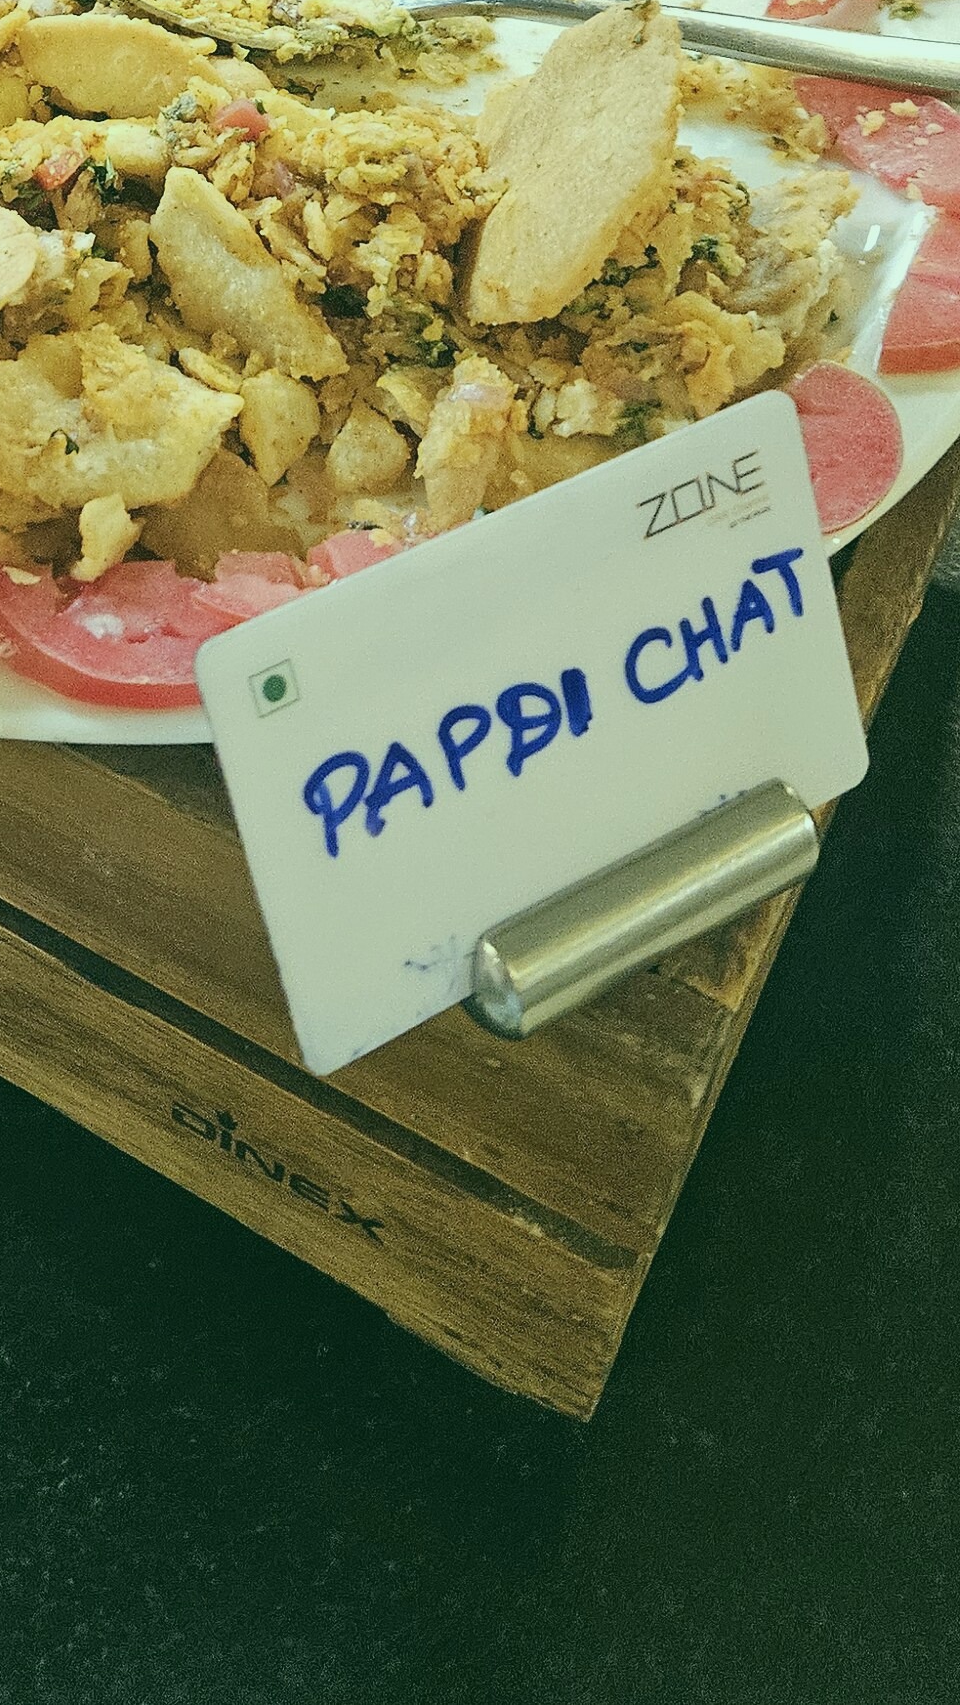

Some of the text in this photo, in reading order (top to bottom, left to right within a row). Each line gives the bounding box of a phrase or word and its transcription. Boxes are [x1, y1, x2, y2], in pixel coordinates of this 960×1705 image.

[637, 450, 765, 539] ZONE
[303, 548, 804, 858] PAPDI CHAT
